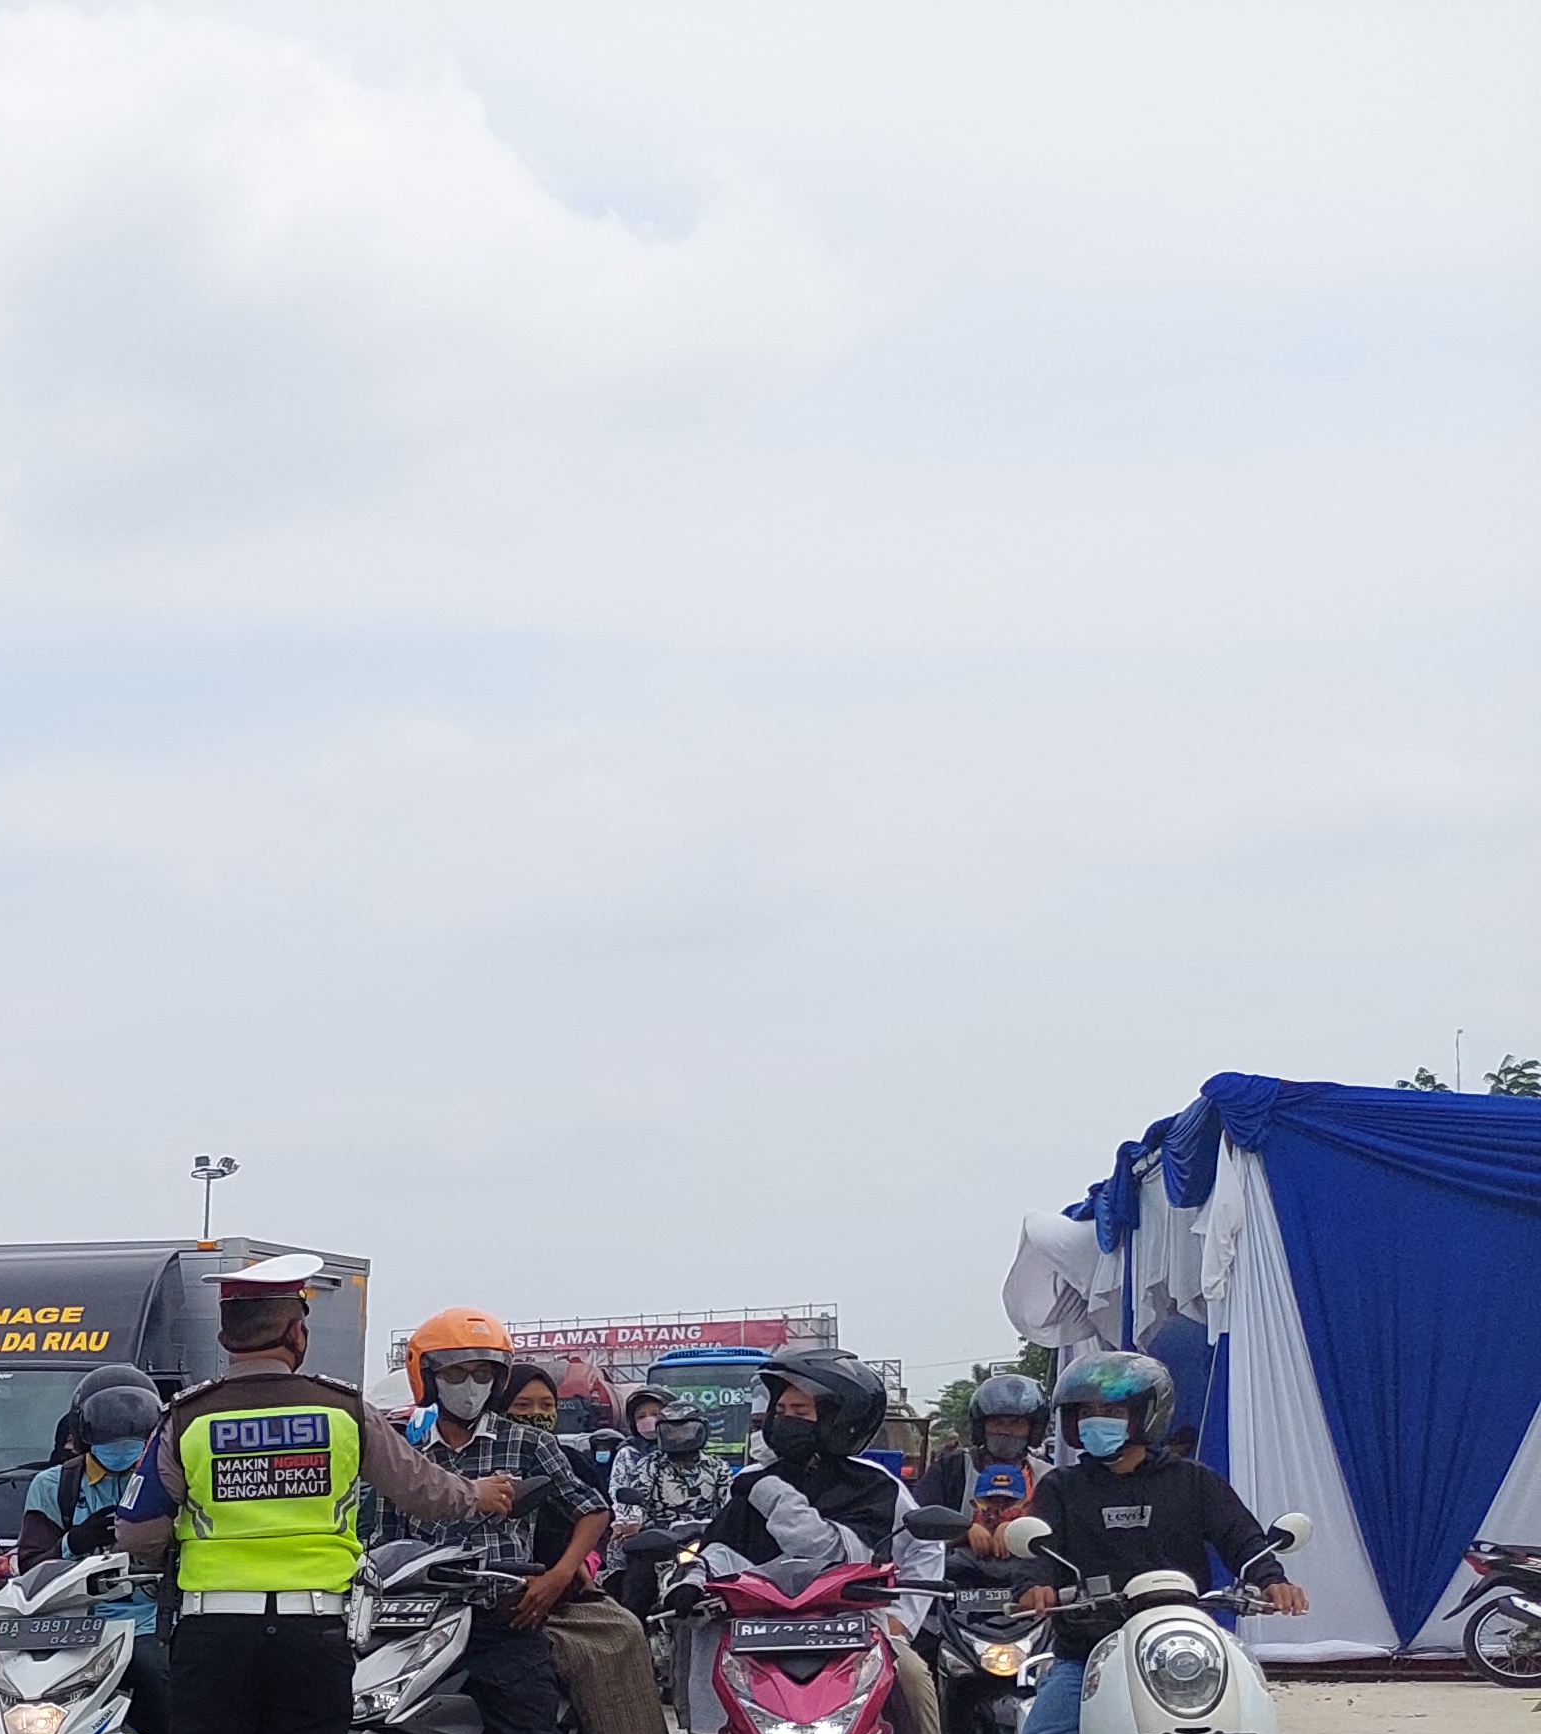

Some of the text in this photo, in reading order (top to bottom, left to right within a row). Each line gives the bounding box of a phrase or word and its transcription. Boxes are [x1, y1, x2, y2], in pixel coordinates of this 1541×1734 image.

[42, 1330, 110, 1352] RIAU
[514, 1325, 702, 1348] SELAMAT DATANG
[721, 1390, 745, 1405] 03
[217, 1416, 324, 1450] POLISI
[217, 1457, 269, 1472] MAKIN
[217, 1467, 327, 1486] MAKIN DEKAT
[217, 1480, 328, 1499] DENGAN MAUT
[30, 1619, 69, 1633] 3891
